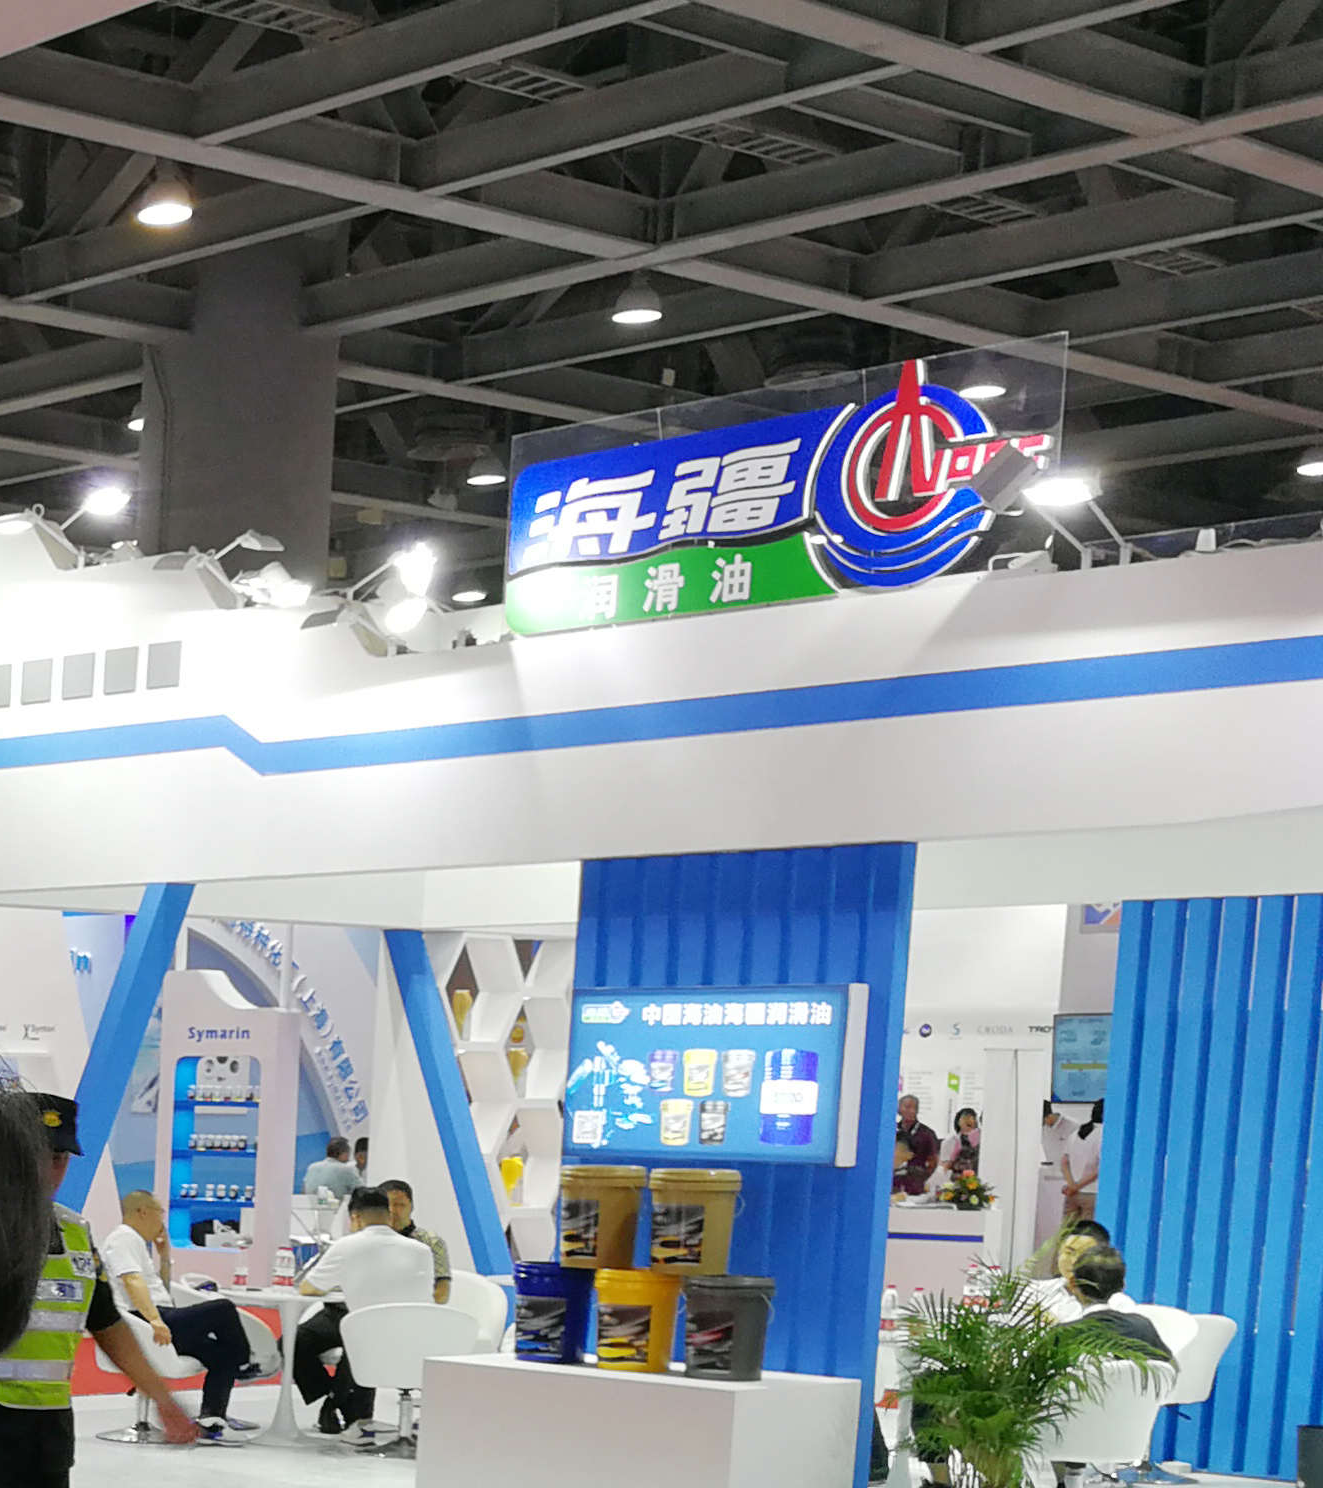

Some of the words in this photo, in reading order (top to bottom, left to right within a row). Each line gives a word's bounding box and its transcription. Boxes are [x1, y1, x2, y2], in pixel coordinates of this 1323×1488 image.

[521, 437, 801, 560] 海疆
[578, 554, 752, 621] 润滑油
[188, 1026, 251, 1042] Symarin
